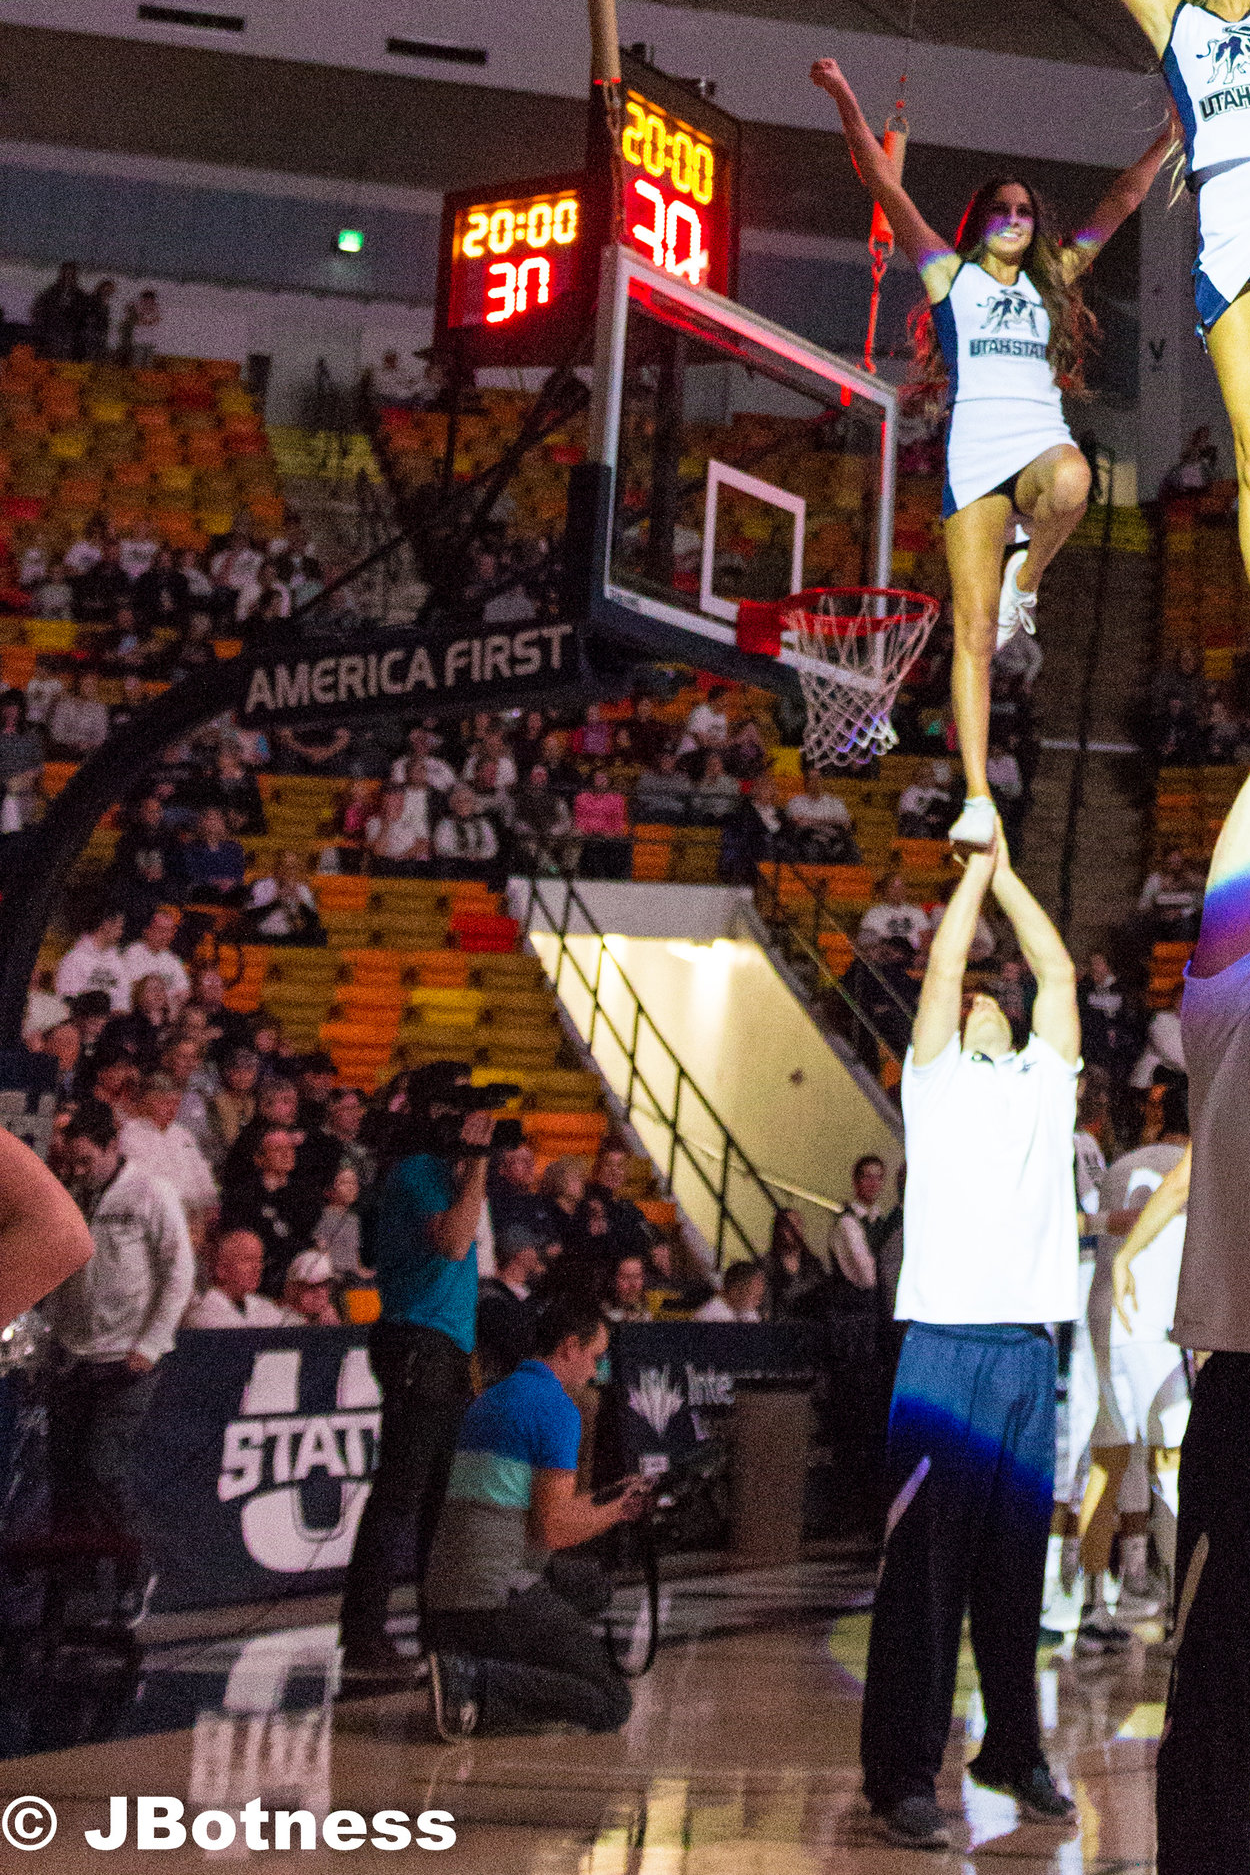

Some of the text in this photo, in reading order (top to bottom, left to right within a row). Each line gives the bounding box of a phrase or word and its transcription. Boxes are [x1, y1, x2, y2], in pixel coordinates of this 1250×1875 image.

[622, 101, 714, 205] 20:00
[462, 198, 578, 258] 20:00
[969, 337, 1012, 358] UTAH
[245, 624, 573, 714] AMERICA FIRST
[217, 1410, 383, 1503] STAT
